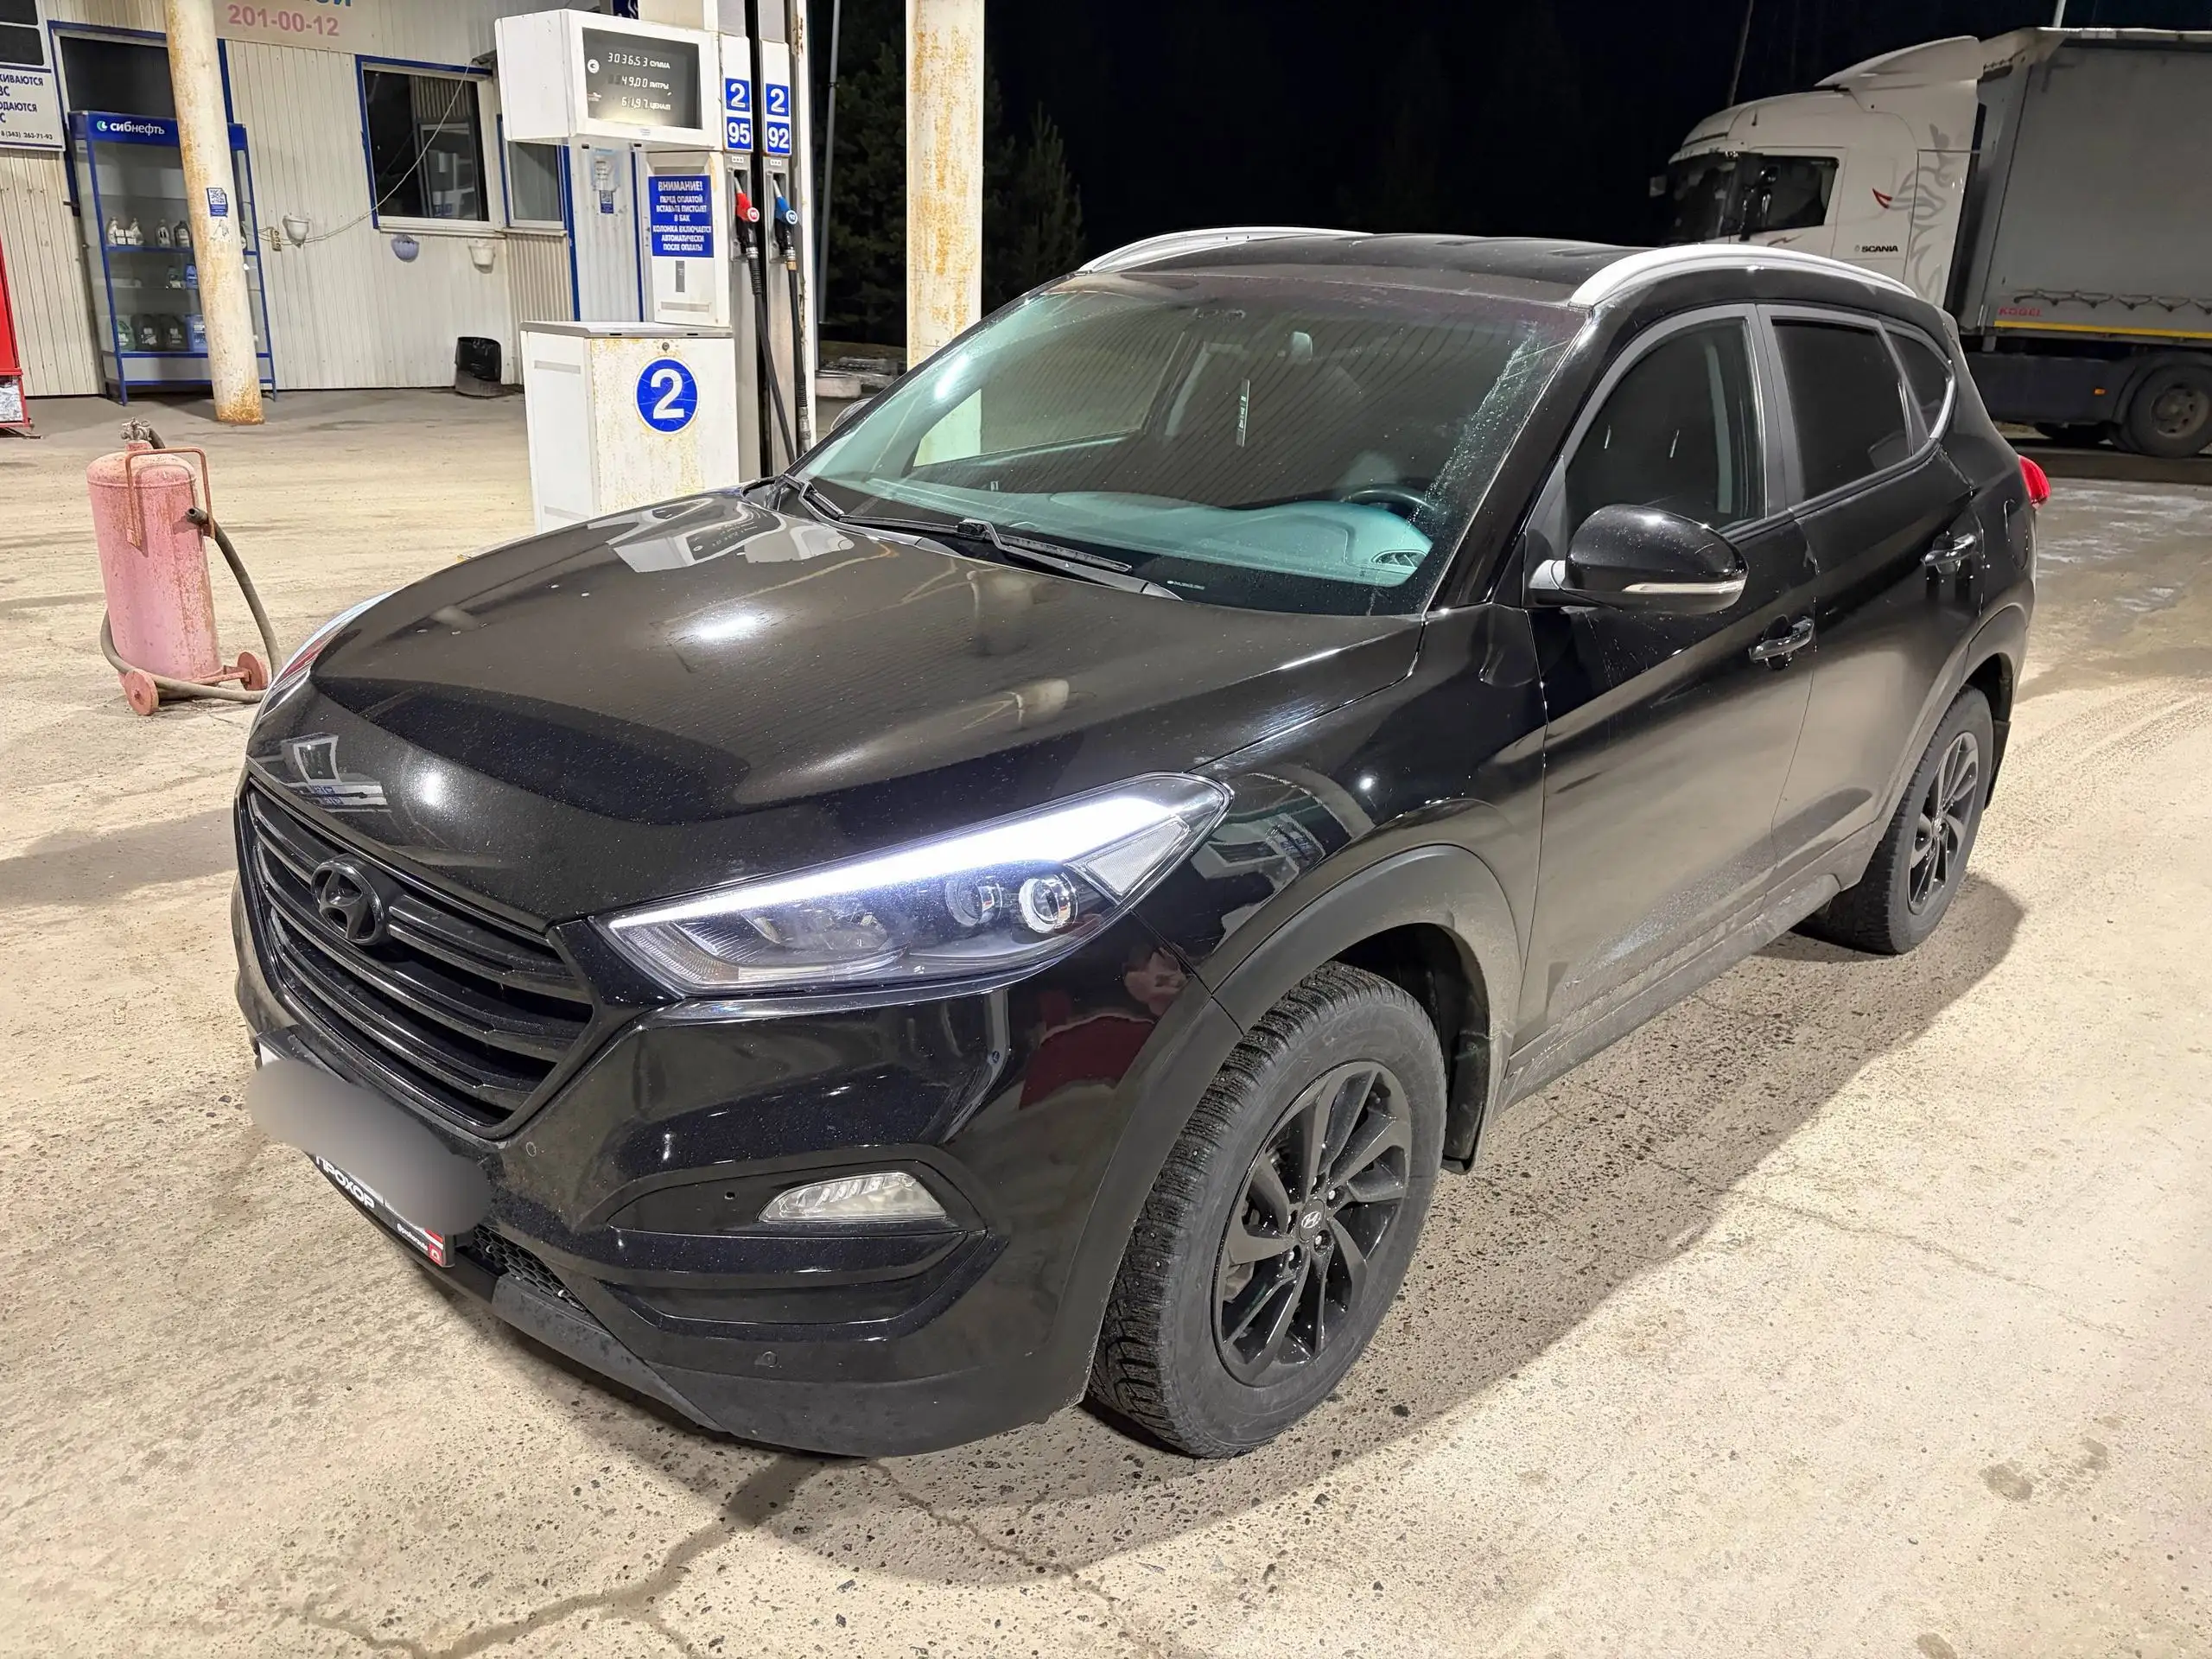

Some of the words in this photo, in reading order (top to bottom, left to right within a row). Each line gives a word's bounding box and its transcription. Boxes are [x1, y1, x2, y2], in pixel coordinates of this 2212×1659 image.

[226, 4, 340, 36] 201-00-12
[729, 83, 746, 108] 2
[770, 88, 785, 113] 2
[110, 121, 165, 136] сибнефть
[728, 122, 750, 144] 95
[767, 126, 789, 149] 92
[658, 181, 703, 192] ВНИМАНИЕ!
[650, 368, 685, 419] 2
[315, 1155, 375, 1209] ПРОХОР
